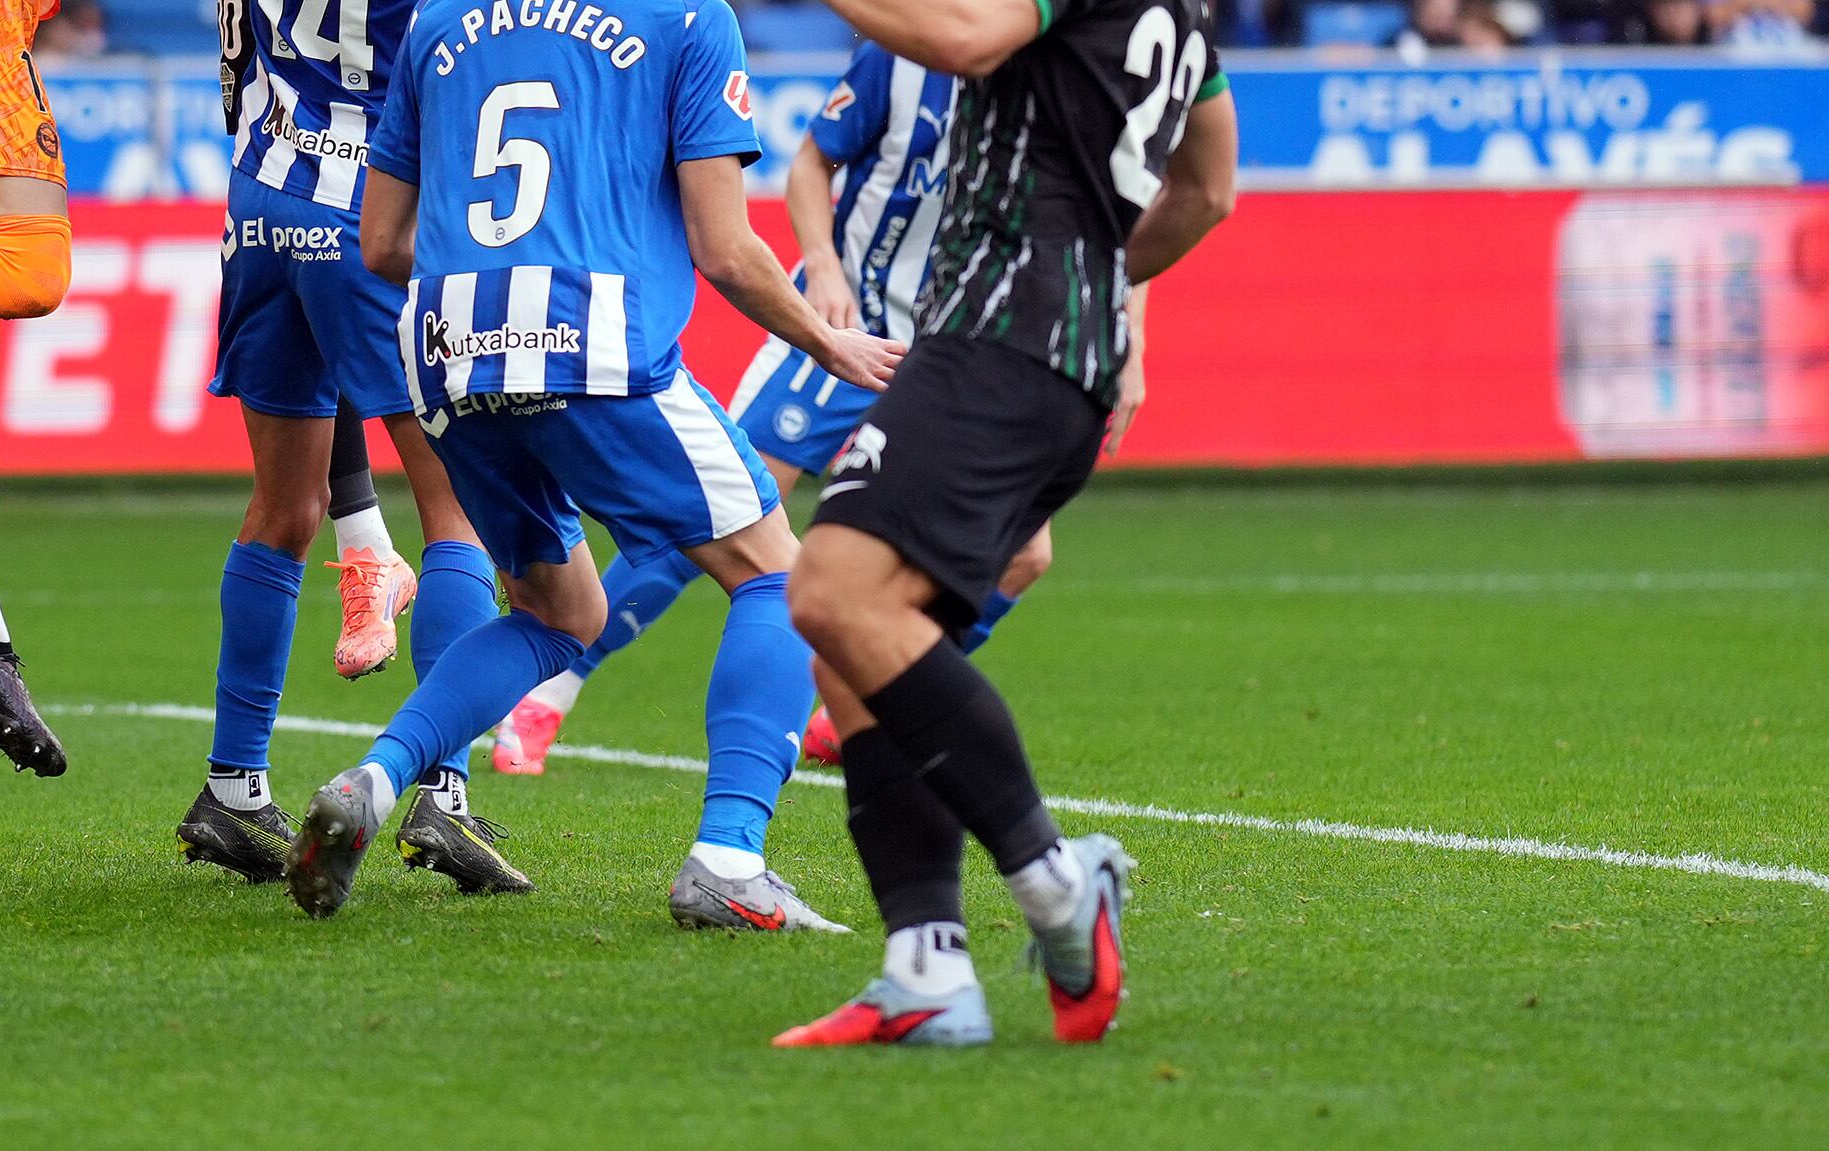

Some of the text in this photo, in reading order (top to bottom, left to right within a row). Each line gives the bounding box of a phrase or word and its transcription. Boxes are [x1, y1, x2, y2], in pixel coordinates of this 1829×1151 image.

[466, 80, 561, 248] 5
[242, 217, 343, 252] El proex
[315, 250, 342, 261] Axia
[424, 312, 581, 366] Kutxabank
[511, 399, 568, 416] Grupo Axia
